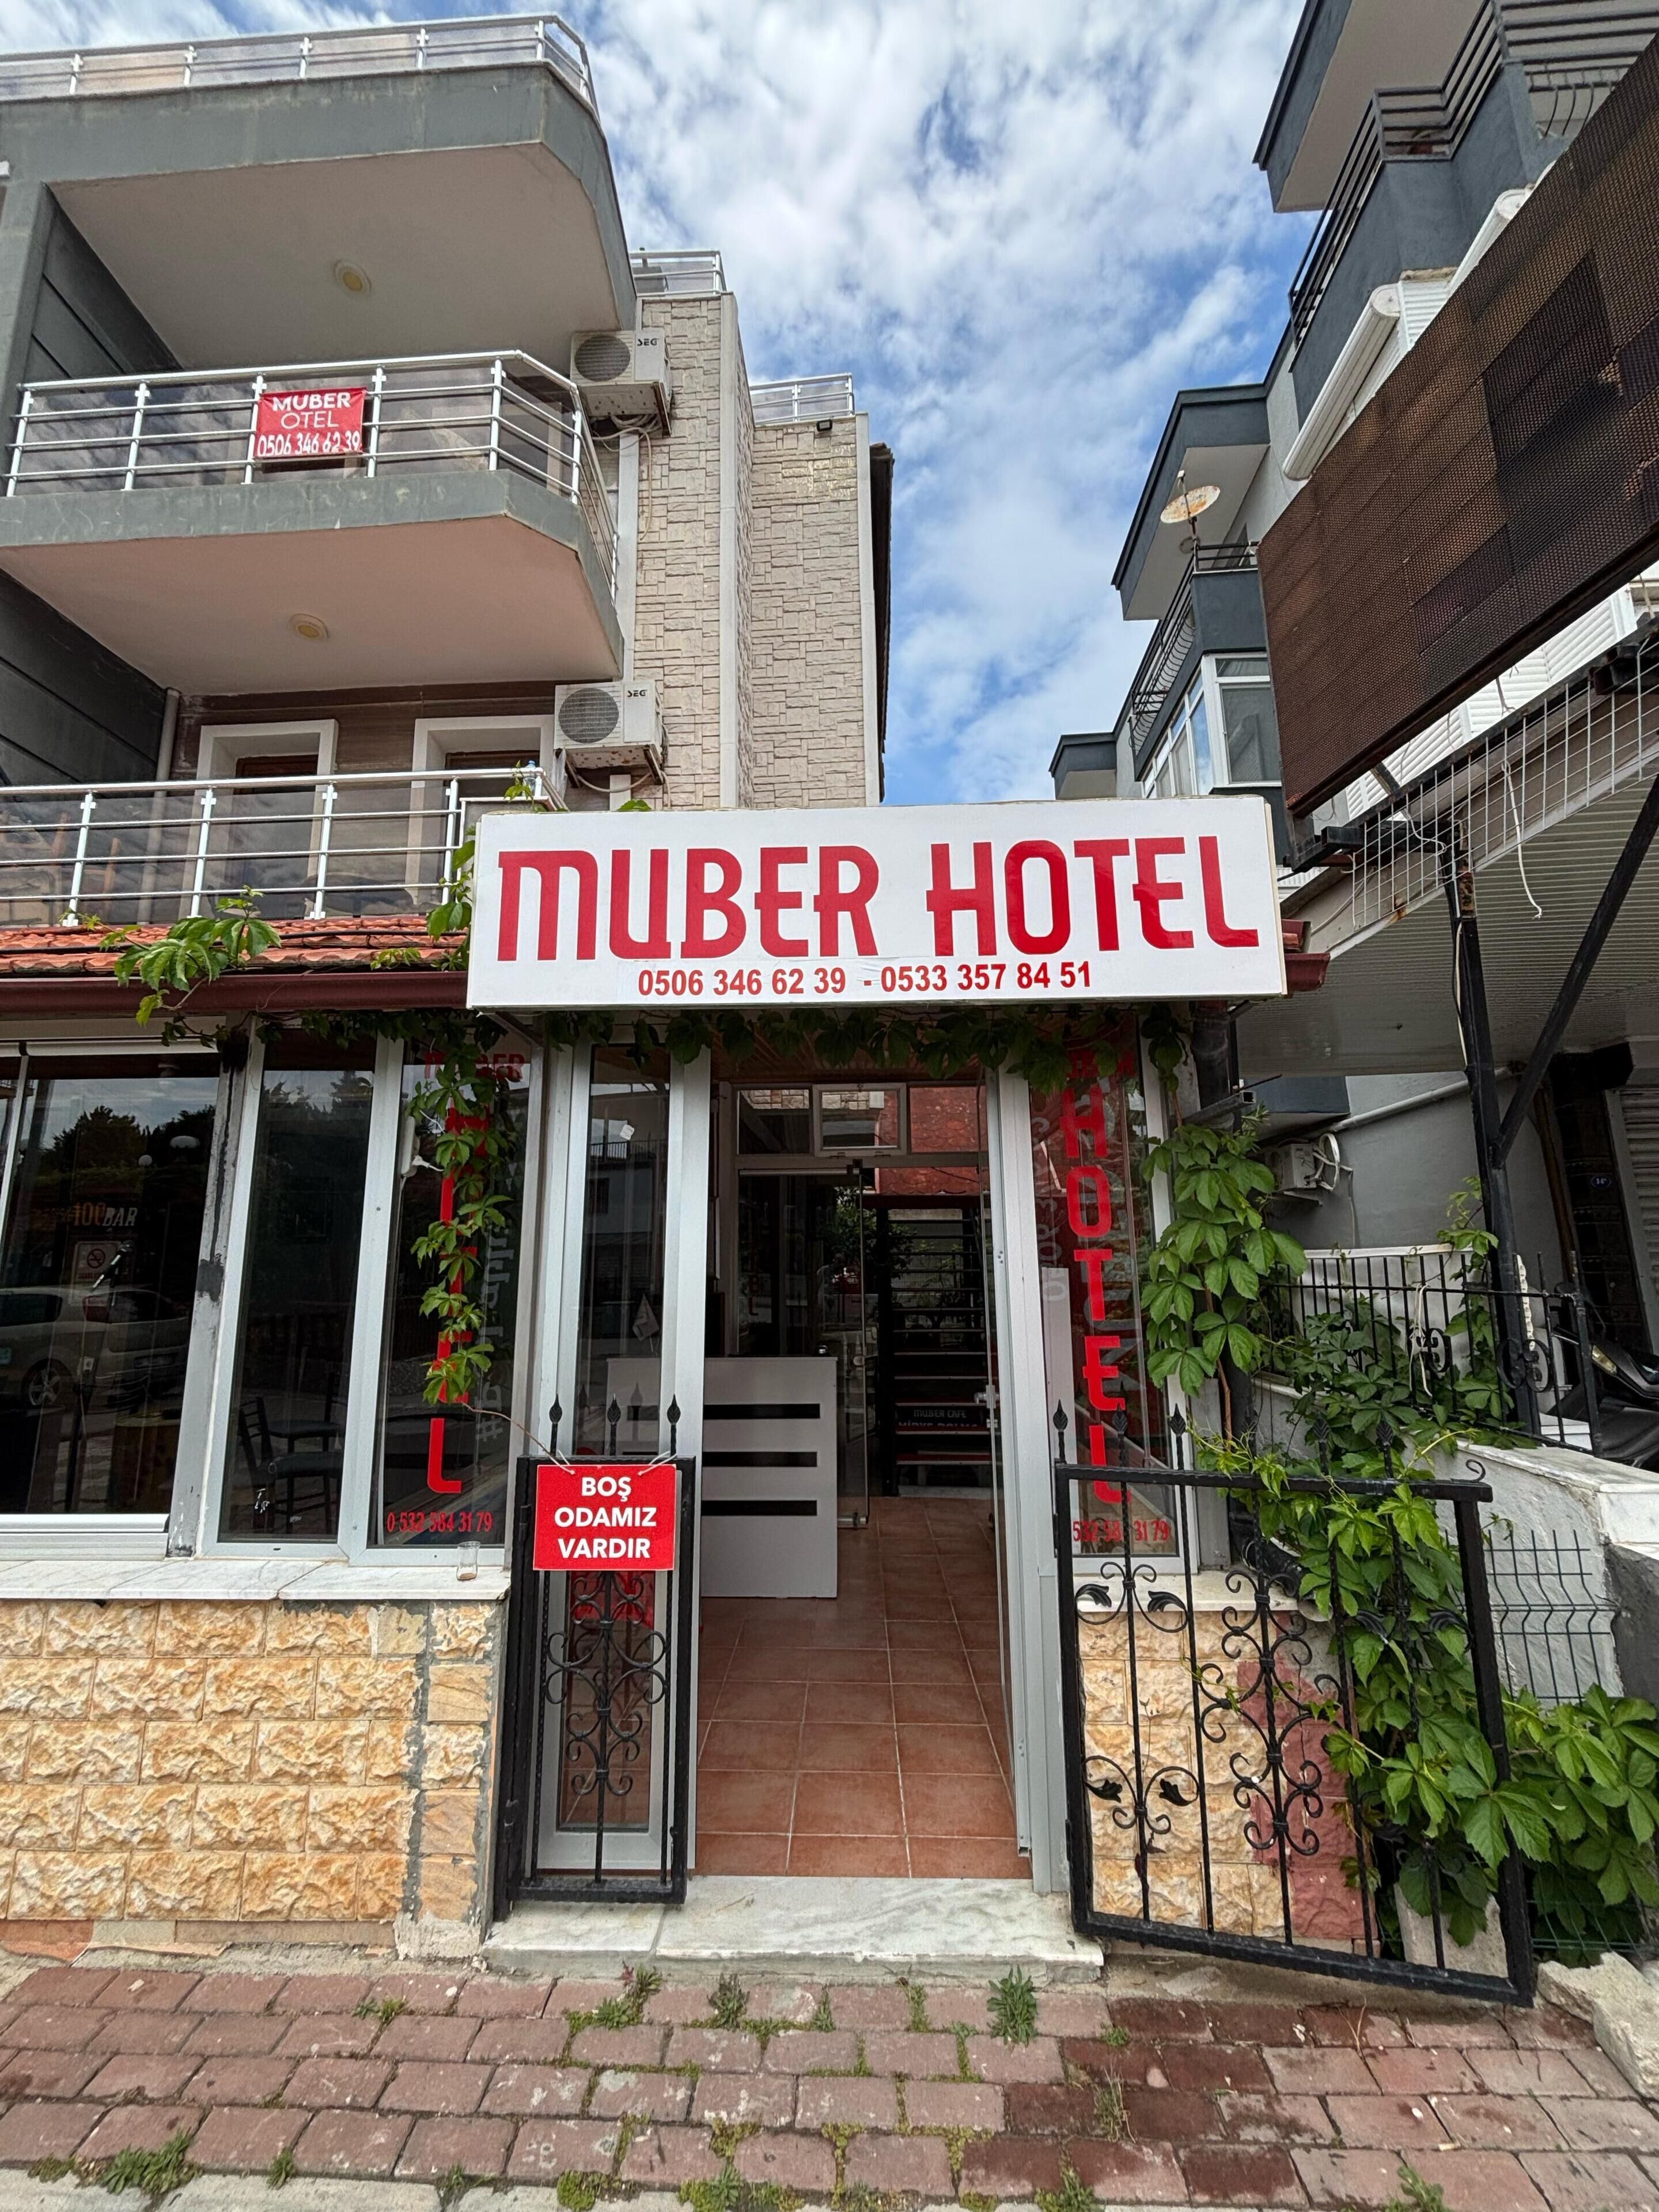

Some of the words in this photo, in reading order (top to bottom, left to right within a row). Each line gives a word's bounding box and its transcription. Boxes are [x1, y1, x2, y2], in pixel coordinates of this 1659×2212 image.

[637, 338, 658, 346] SEG
[272, 392, 351, 412] MUBER
[281, 410, 339, 430] OTEL
[257, 433, 292, 457] 0506
[294, 432, 319, 454] 346
[322, 431, 340, 453] 62
[343, 430, 361, 452] 39
[627, 690, 646, 698] SEG
[496, 844, 880, 961] MUBER
[926, 835, 1259, 956] HOTEL
[638, 969, 703, 997] 0506
[713, 968, 762, 996] 346
[771, 968, 804, 995] 62
[813, 967, 846, 994] 39
[881, 964, 948, 993] 0533
[957, 963, 1006, 991] 357
[1017, 962, 1051, 990] 84
[1060, 960, 1091, 988] 51
[1059, 1083, 1131, 1503] HOTEL
[913, 1409, 945, 1418] MUBER
[581, 1476, 632, 1502] BOŞ
[387, 1512, 396, 1533] 0
[399, 1511, 425, 1533] 532
[458, 1510, 473, 1532] 31
[476, 1511, 493, 1532] 79
[554, 1506, 657, 1528] ODAMIZ
[1133, 1520, 1149, 1541] 31
[1151, 1519, 1170, 1541] 79
[557, 1538, 651, 1559] VARDIR
